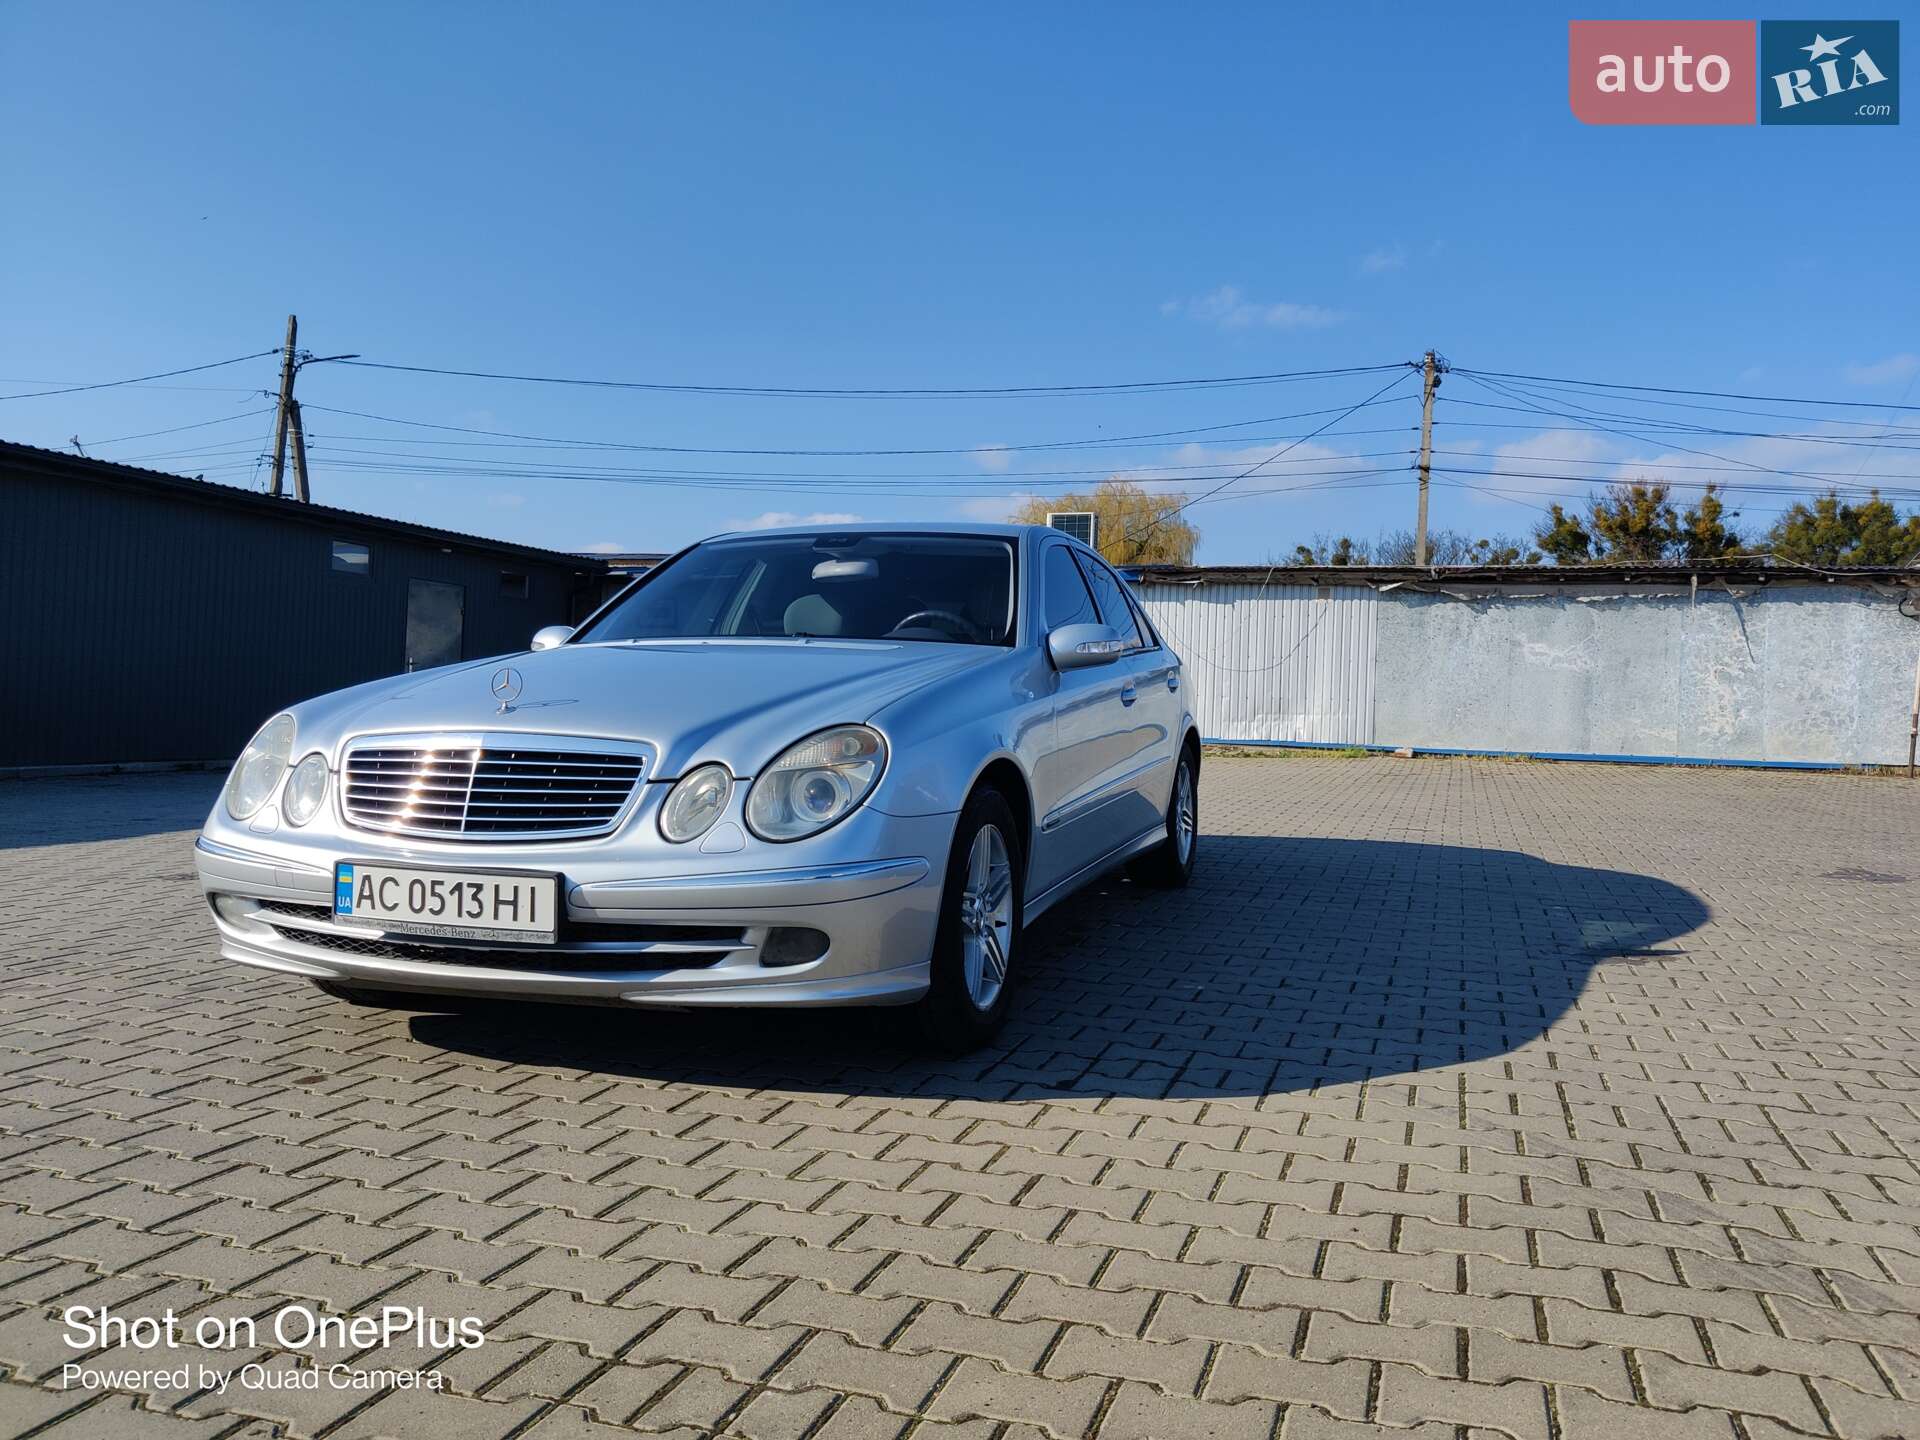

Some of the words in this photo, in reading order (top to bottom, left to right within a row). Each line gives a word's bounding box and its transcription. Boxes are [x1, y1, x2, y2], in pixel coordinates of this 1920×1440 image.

[338, 896, 351, 908] UA
[356, 874, 400, 911] AC
[408, 878, 484, 919] 0513
[493, 884, 536, 923] HI
